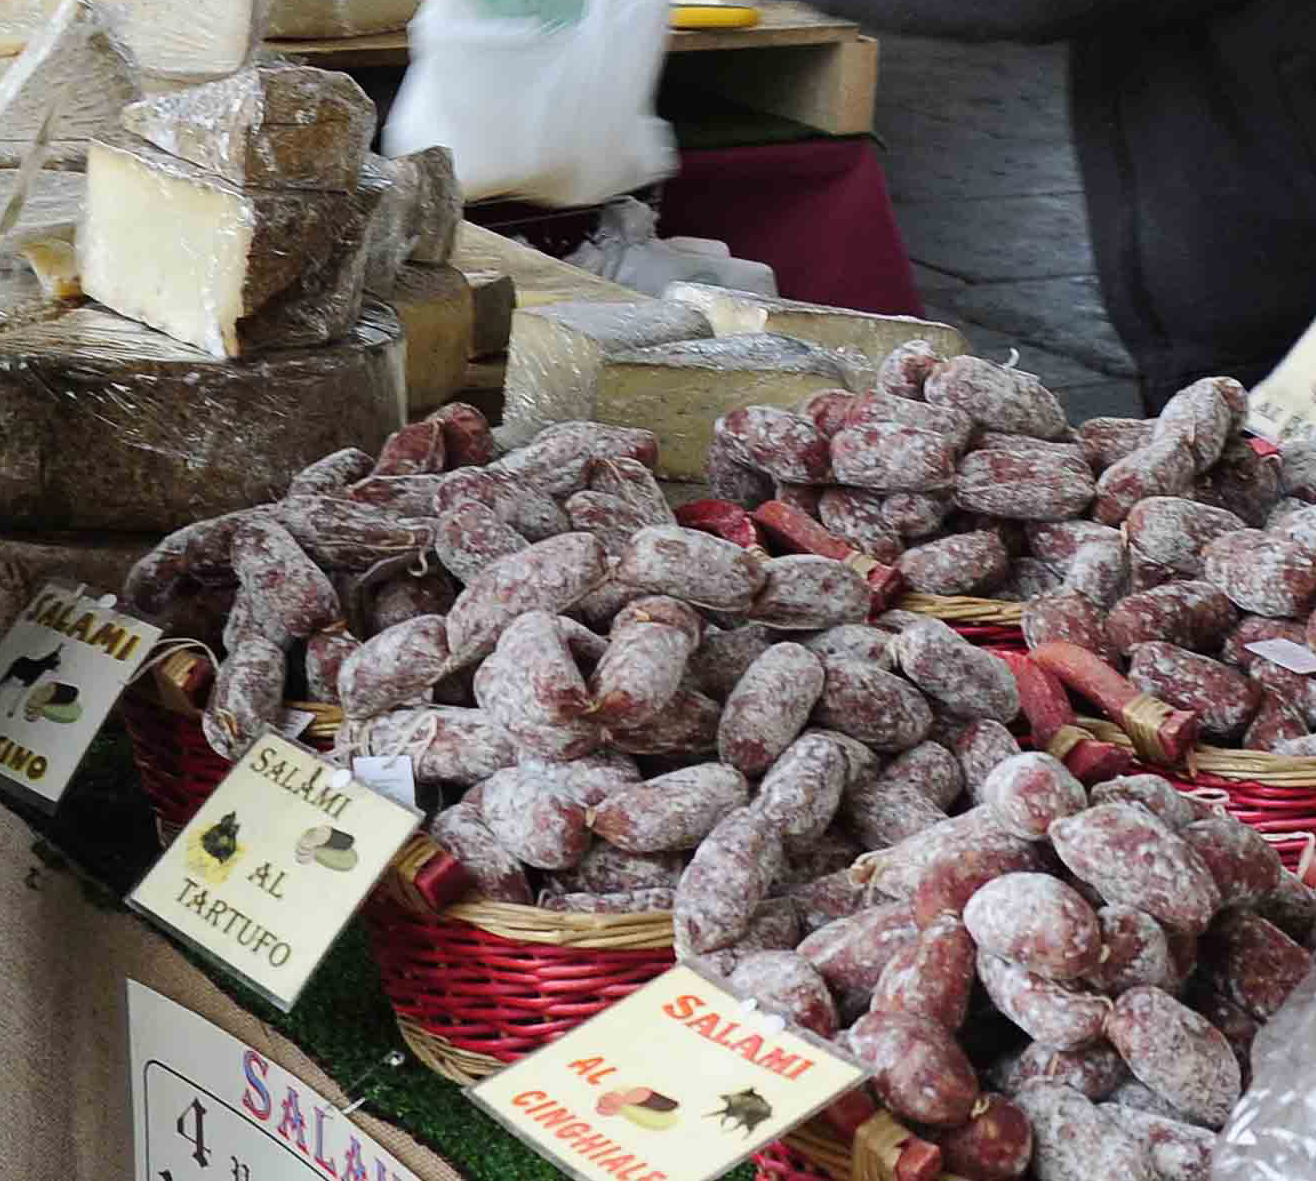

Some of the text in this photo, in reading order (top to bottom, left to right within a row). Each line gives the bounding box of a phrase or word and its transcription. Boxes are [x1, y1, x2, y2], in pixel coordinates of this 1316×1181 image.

[35, 593, 141, 661] SALAMI
[250, 747, 353, 820] SALAMI
[248, 863, 289, 900] AL
[176, 878, 293, 968] TARTUFO
[567, 1056, 618, 1086] AL
[662, 994, 815, 1081] SALAMI
[511, 1089, 670, 1181] CINGHIALE
